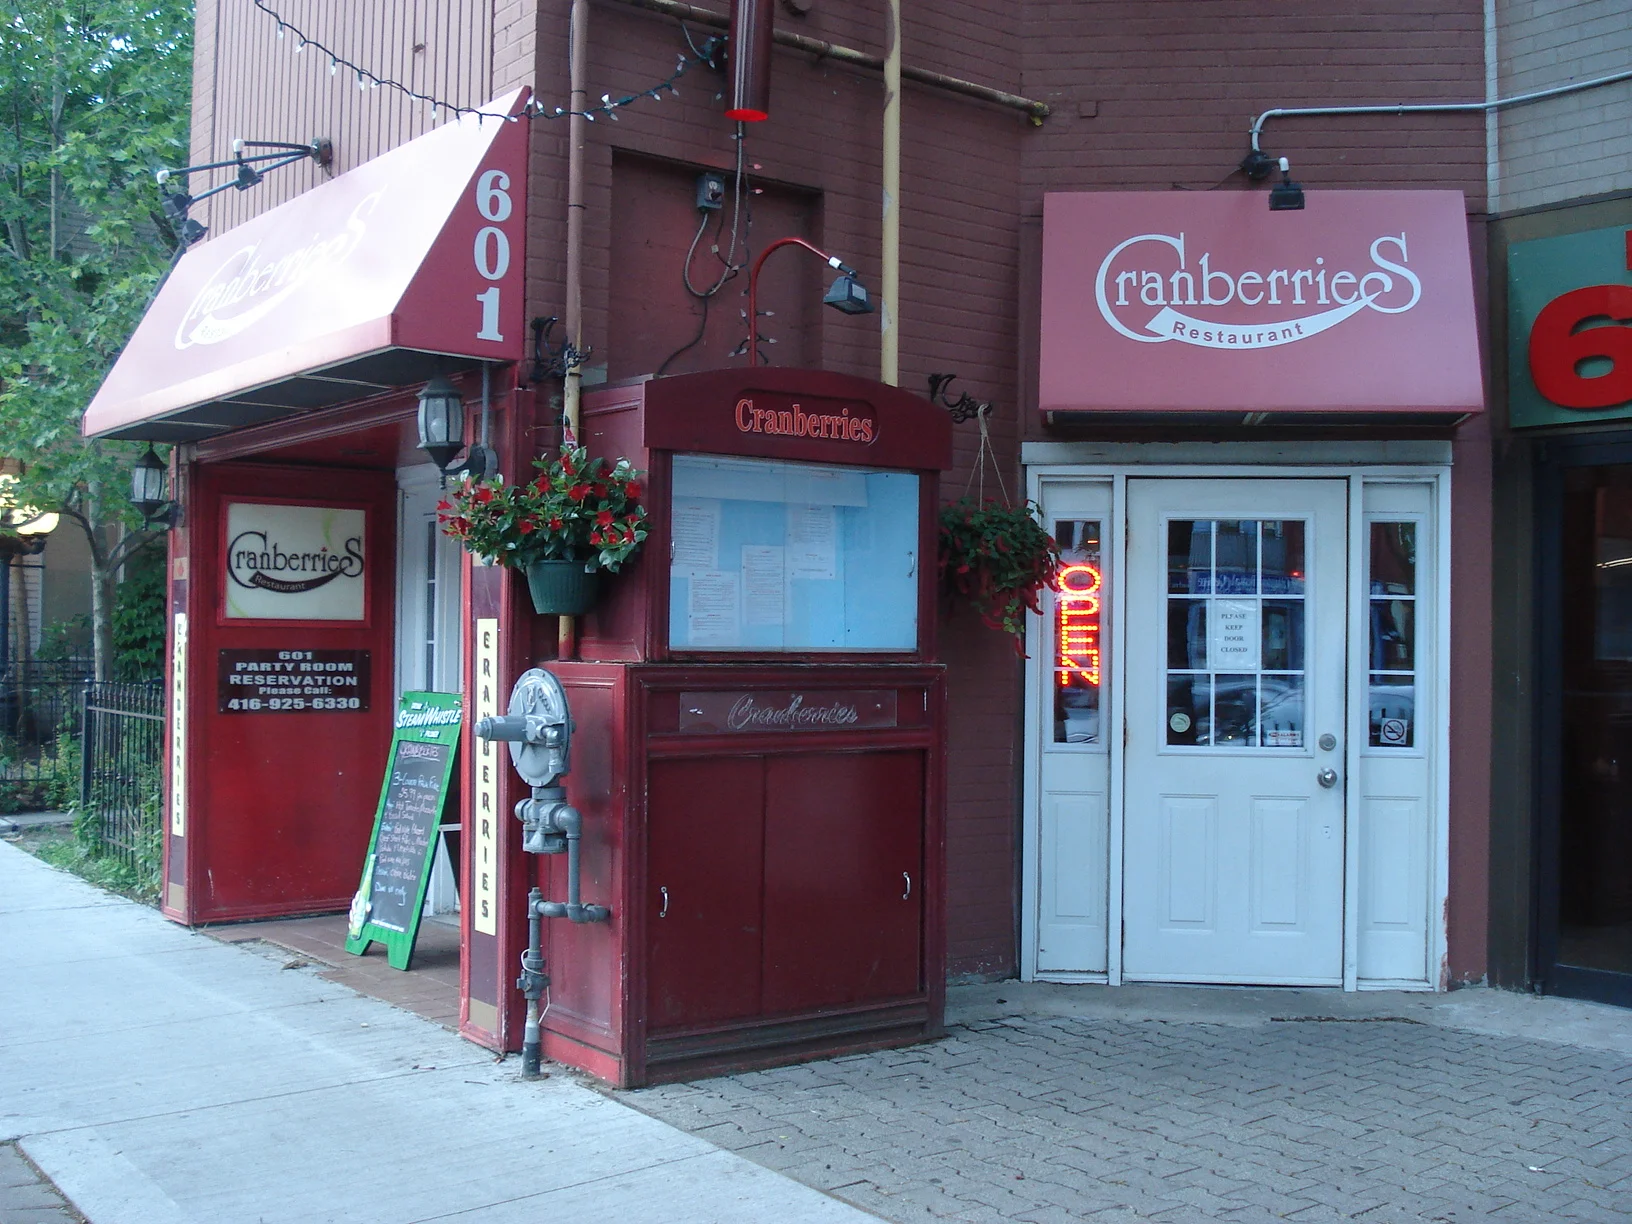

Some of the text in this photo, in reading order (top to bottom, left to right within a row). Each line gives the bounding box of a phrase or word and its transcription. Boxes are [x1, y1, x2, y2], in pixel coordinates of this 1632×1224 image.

[473, 168, 513, 343] 601
[1172, 320, 1304, 345] Restaurant
[735, 398, 874, 443] Cranberries
[254, 574, 306, 591] Restaurant
[1058, 565, 1101, 686] OPEN
[278, 651, 313, 660] 601
[235, 662, 353, 672] PARTY ROOM
[229, 674, 358, 686] RESERVATION
[258, 686, 332, 695] Please Call:
[227, 697, 360, 710] 416-925-6330
[727, 692, 859, 730] Cranberries
